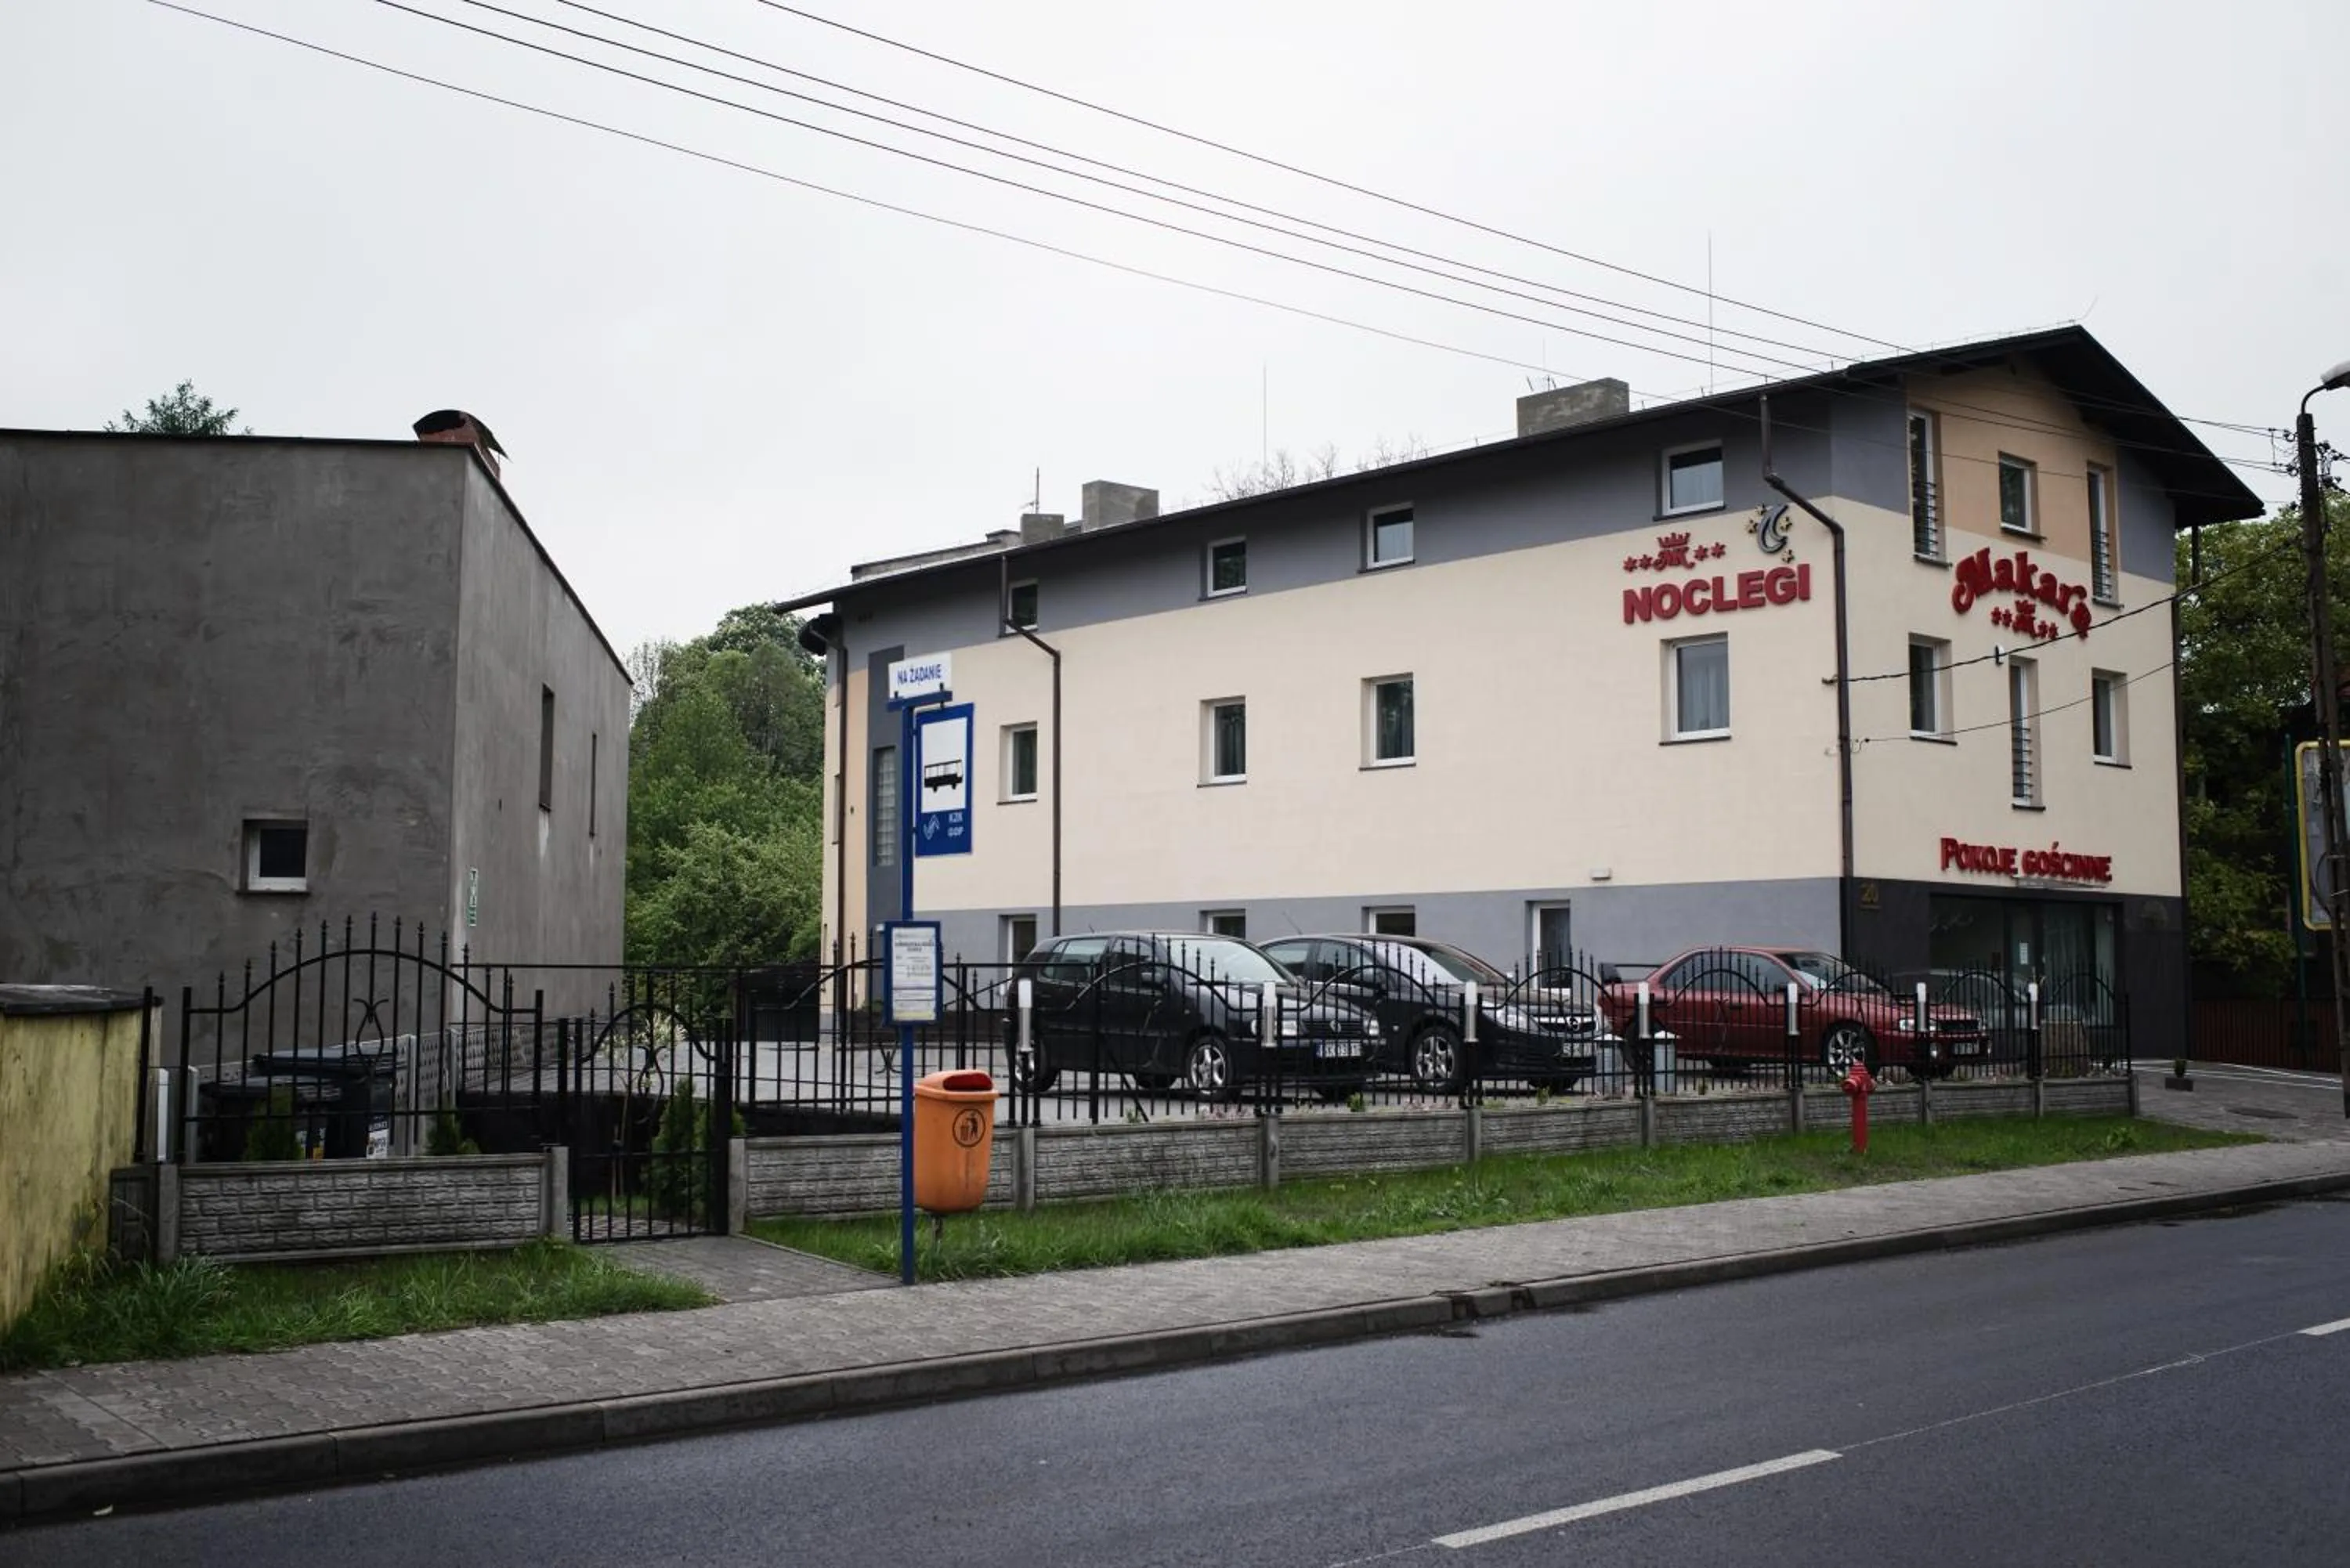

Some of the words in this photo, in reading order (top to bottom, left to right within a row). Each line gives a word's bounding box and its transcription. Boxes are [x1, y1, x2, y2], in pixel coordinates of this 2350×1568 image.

[1623, 564, 1810, 624] NOCLEGI
[897, 669, 908, 685] NA
[2022, 841, 2113, 882] GOŚCINNE
